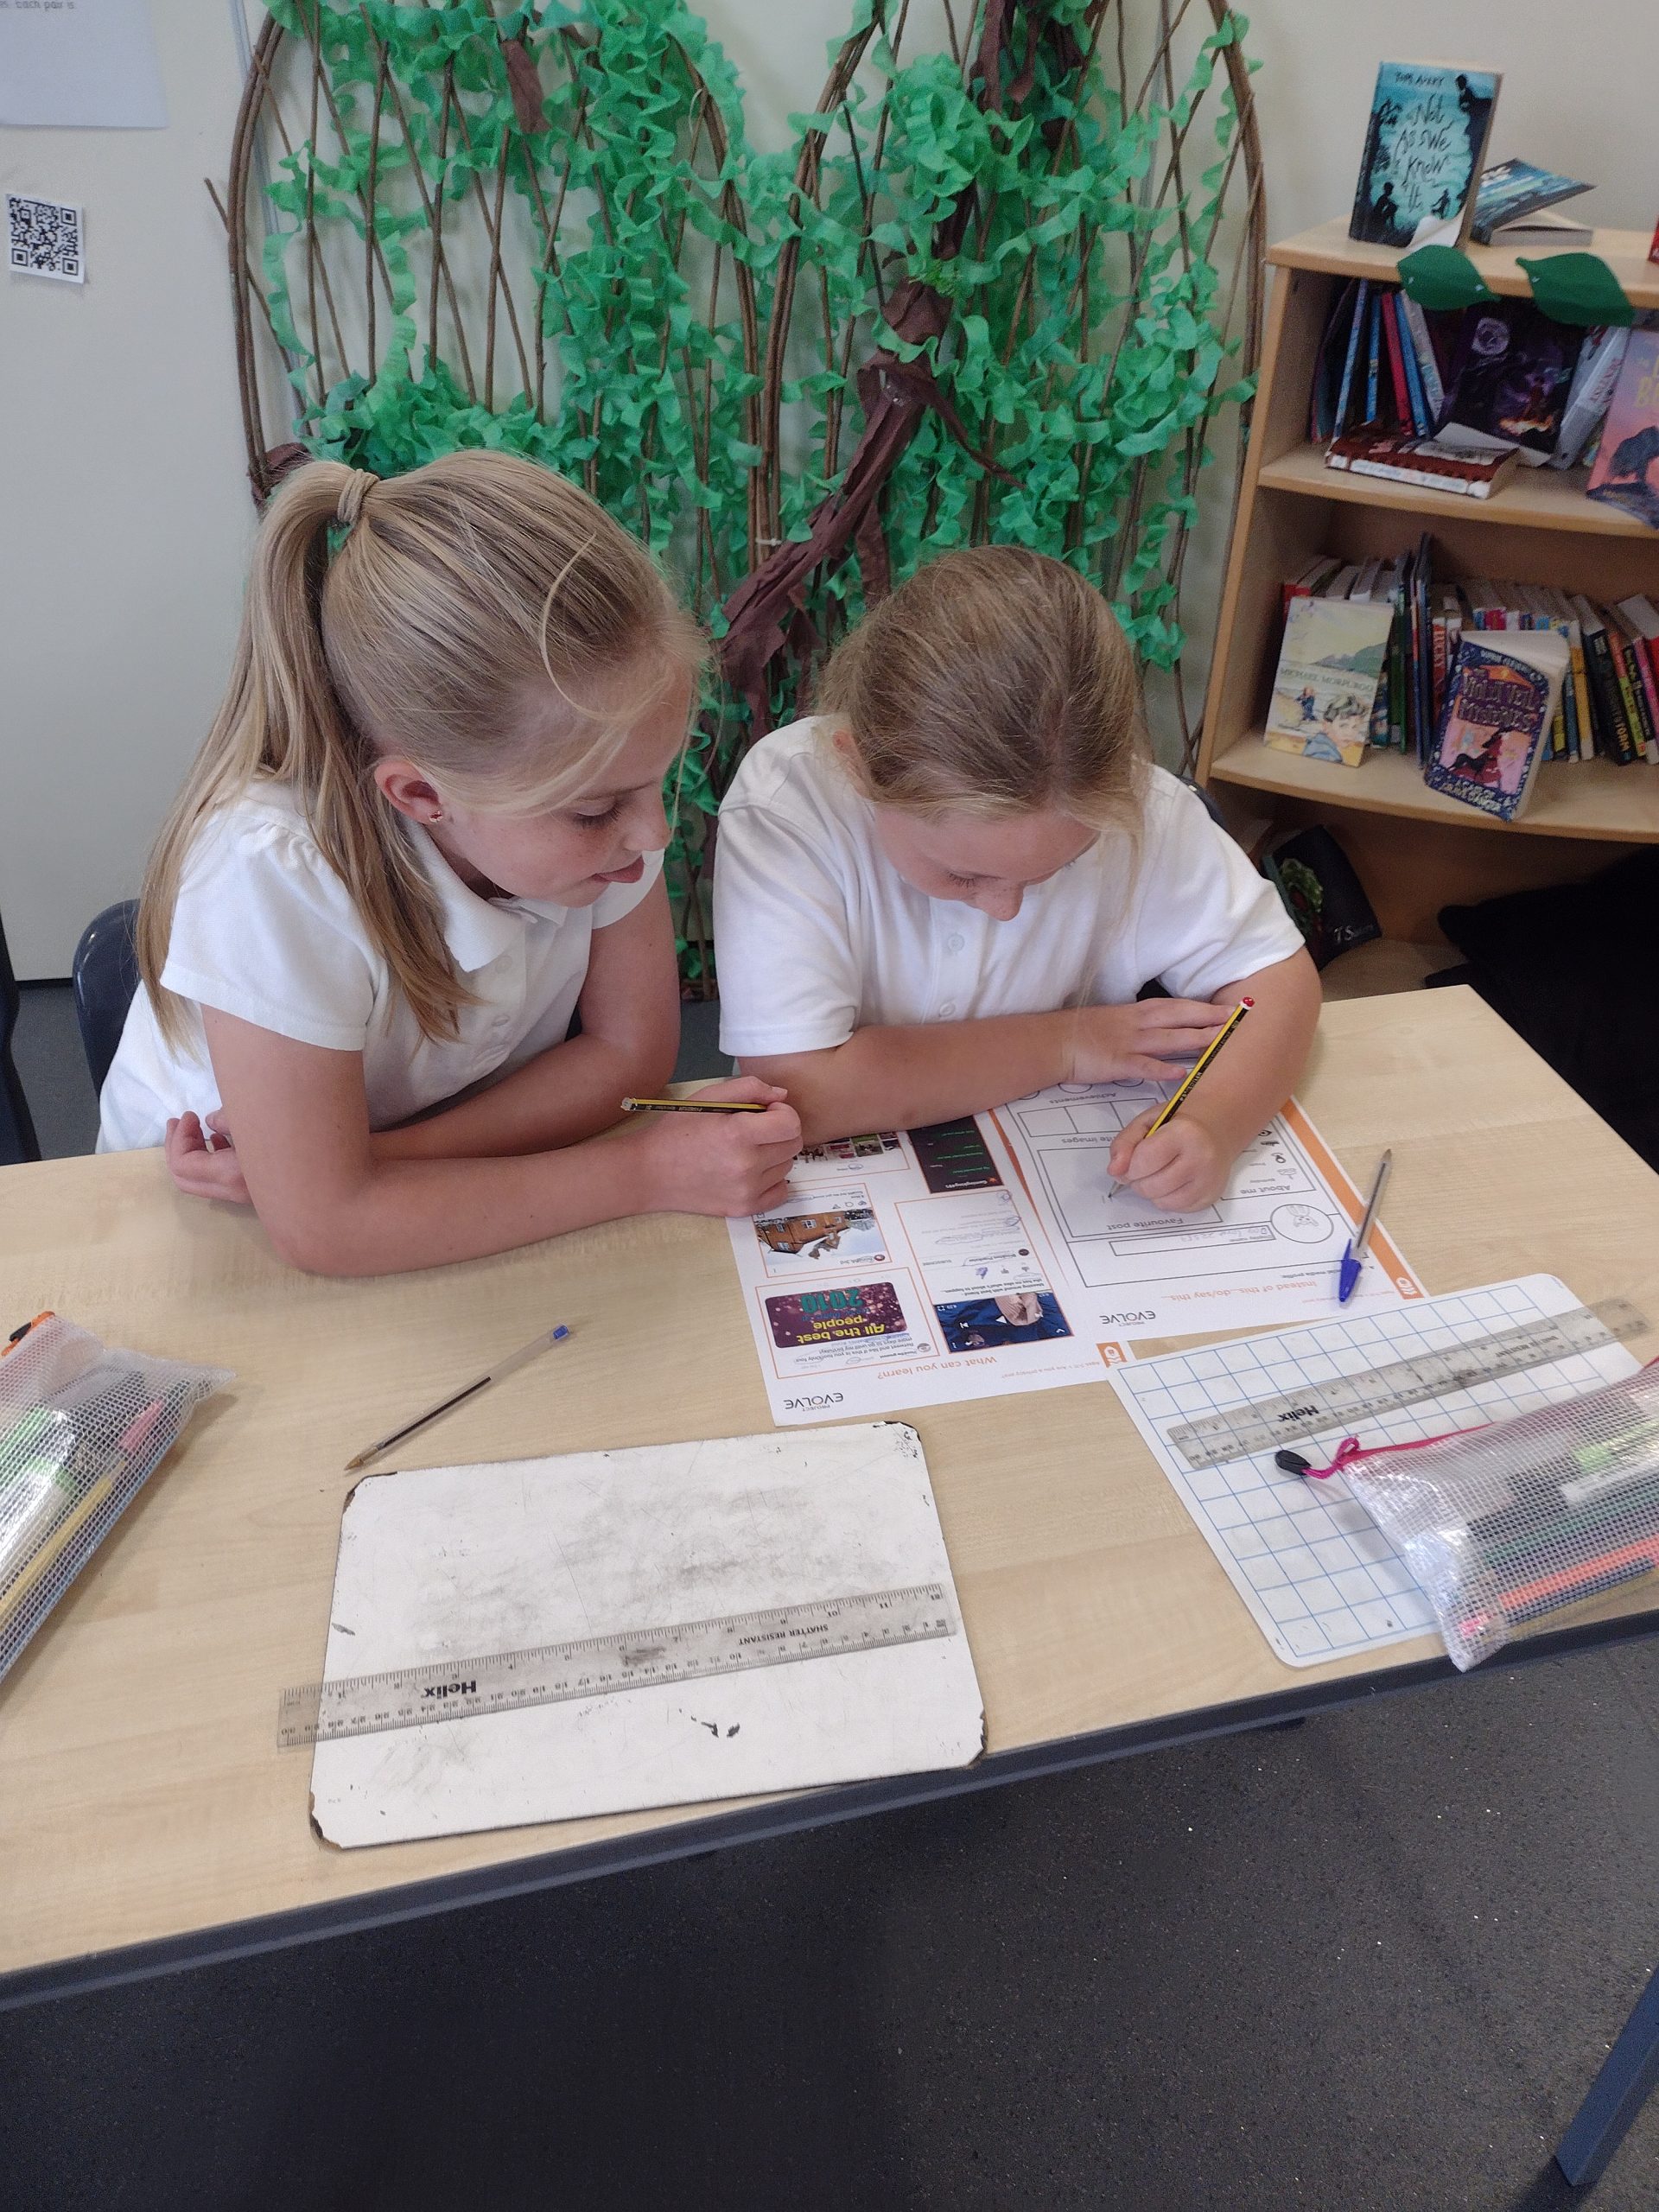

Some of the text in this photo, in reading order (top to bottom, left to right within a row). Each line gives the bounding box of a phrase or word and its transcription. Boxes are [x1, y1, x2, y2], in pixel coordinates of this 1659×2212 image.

[1049, 1092, 1116, 1104] Achievements
[1106, 1217, 1183, 1231] Favourite post
[1277, 1281, 1317, 1291] Instead
[801, 1287, 863, 1313] 2010
[812, 1315, 862, 1330] people
[1099, 1310, 1156, 1324] EVOLVE
[835, 1329, 861, 1338] the
[864, 1324, 885, 1334] All
[796, 1332, 830, 1344] best
[916, 1363, 938, 1372] you
[964, 1357, 997, 1366] What
[877, 1368, 912, 1379] learn?
[783, 1393, 843, 1410] EVOLVE
[1276, 1404, 1320, 1424] Helix
[739, 1624, 829, 1645] SHATTER RESISTANT
[423, 1680, 477, 1700] Helix
